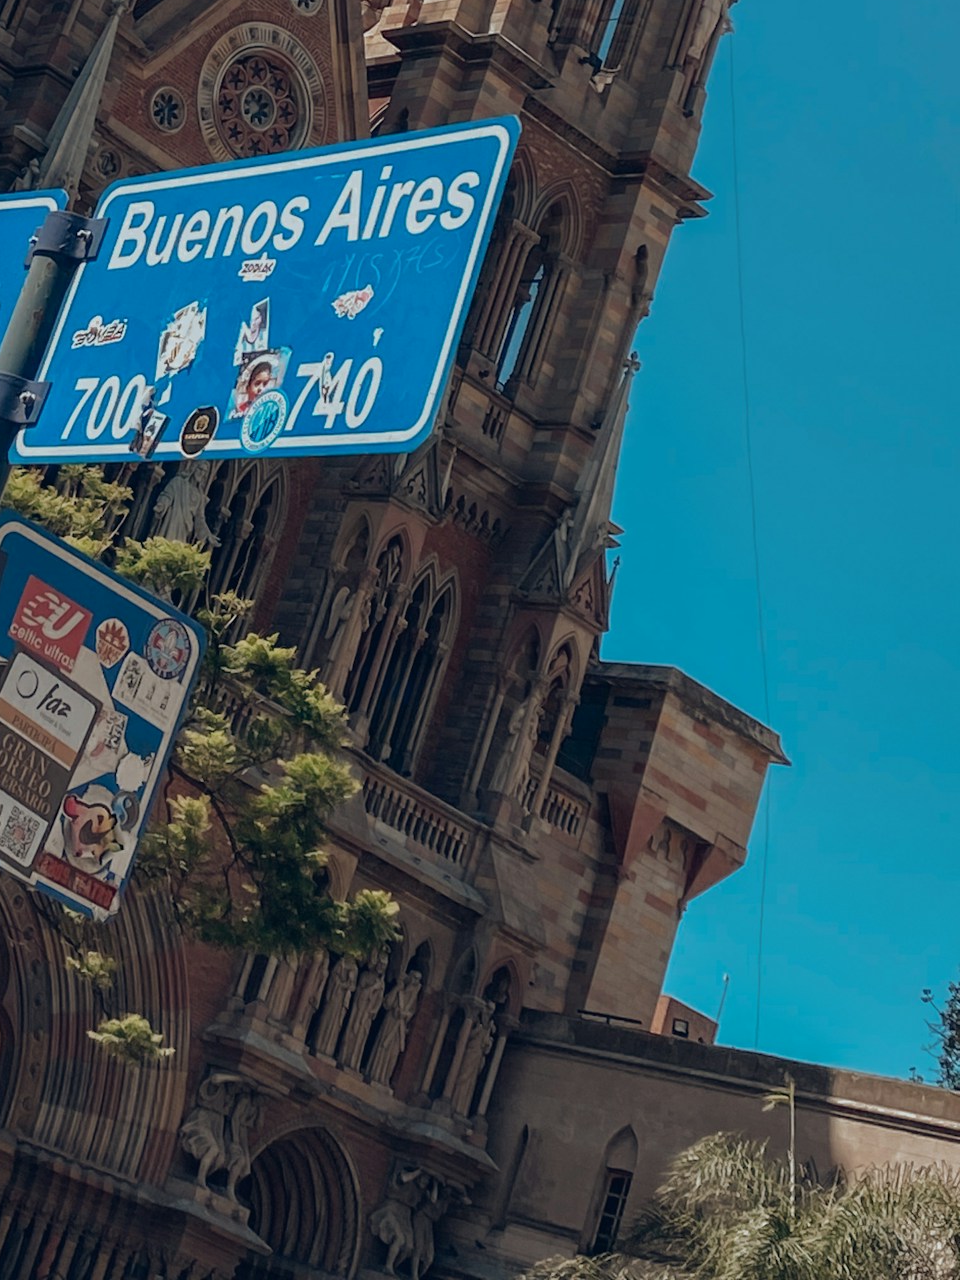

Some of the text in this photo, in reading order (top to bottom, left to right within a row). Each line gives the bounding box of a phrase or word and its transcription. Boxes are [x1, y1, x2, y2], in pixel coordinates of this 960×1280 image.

[106, 192, 310, 272] Buenos
[314, 164, 479, 247] Aires
[61, 357, 383, 440] 700 740
[9, 622, 43, 648] celtic
[44, 642, 75, 670] ultras
[0, 732, 51, 776] GRAN
